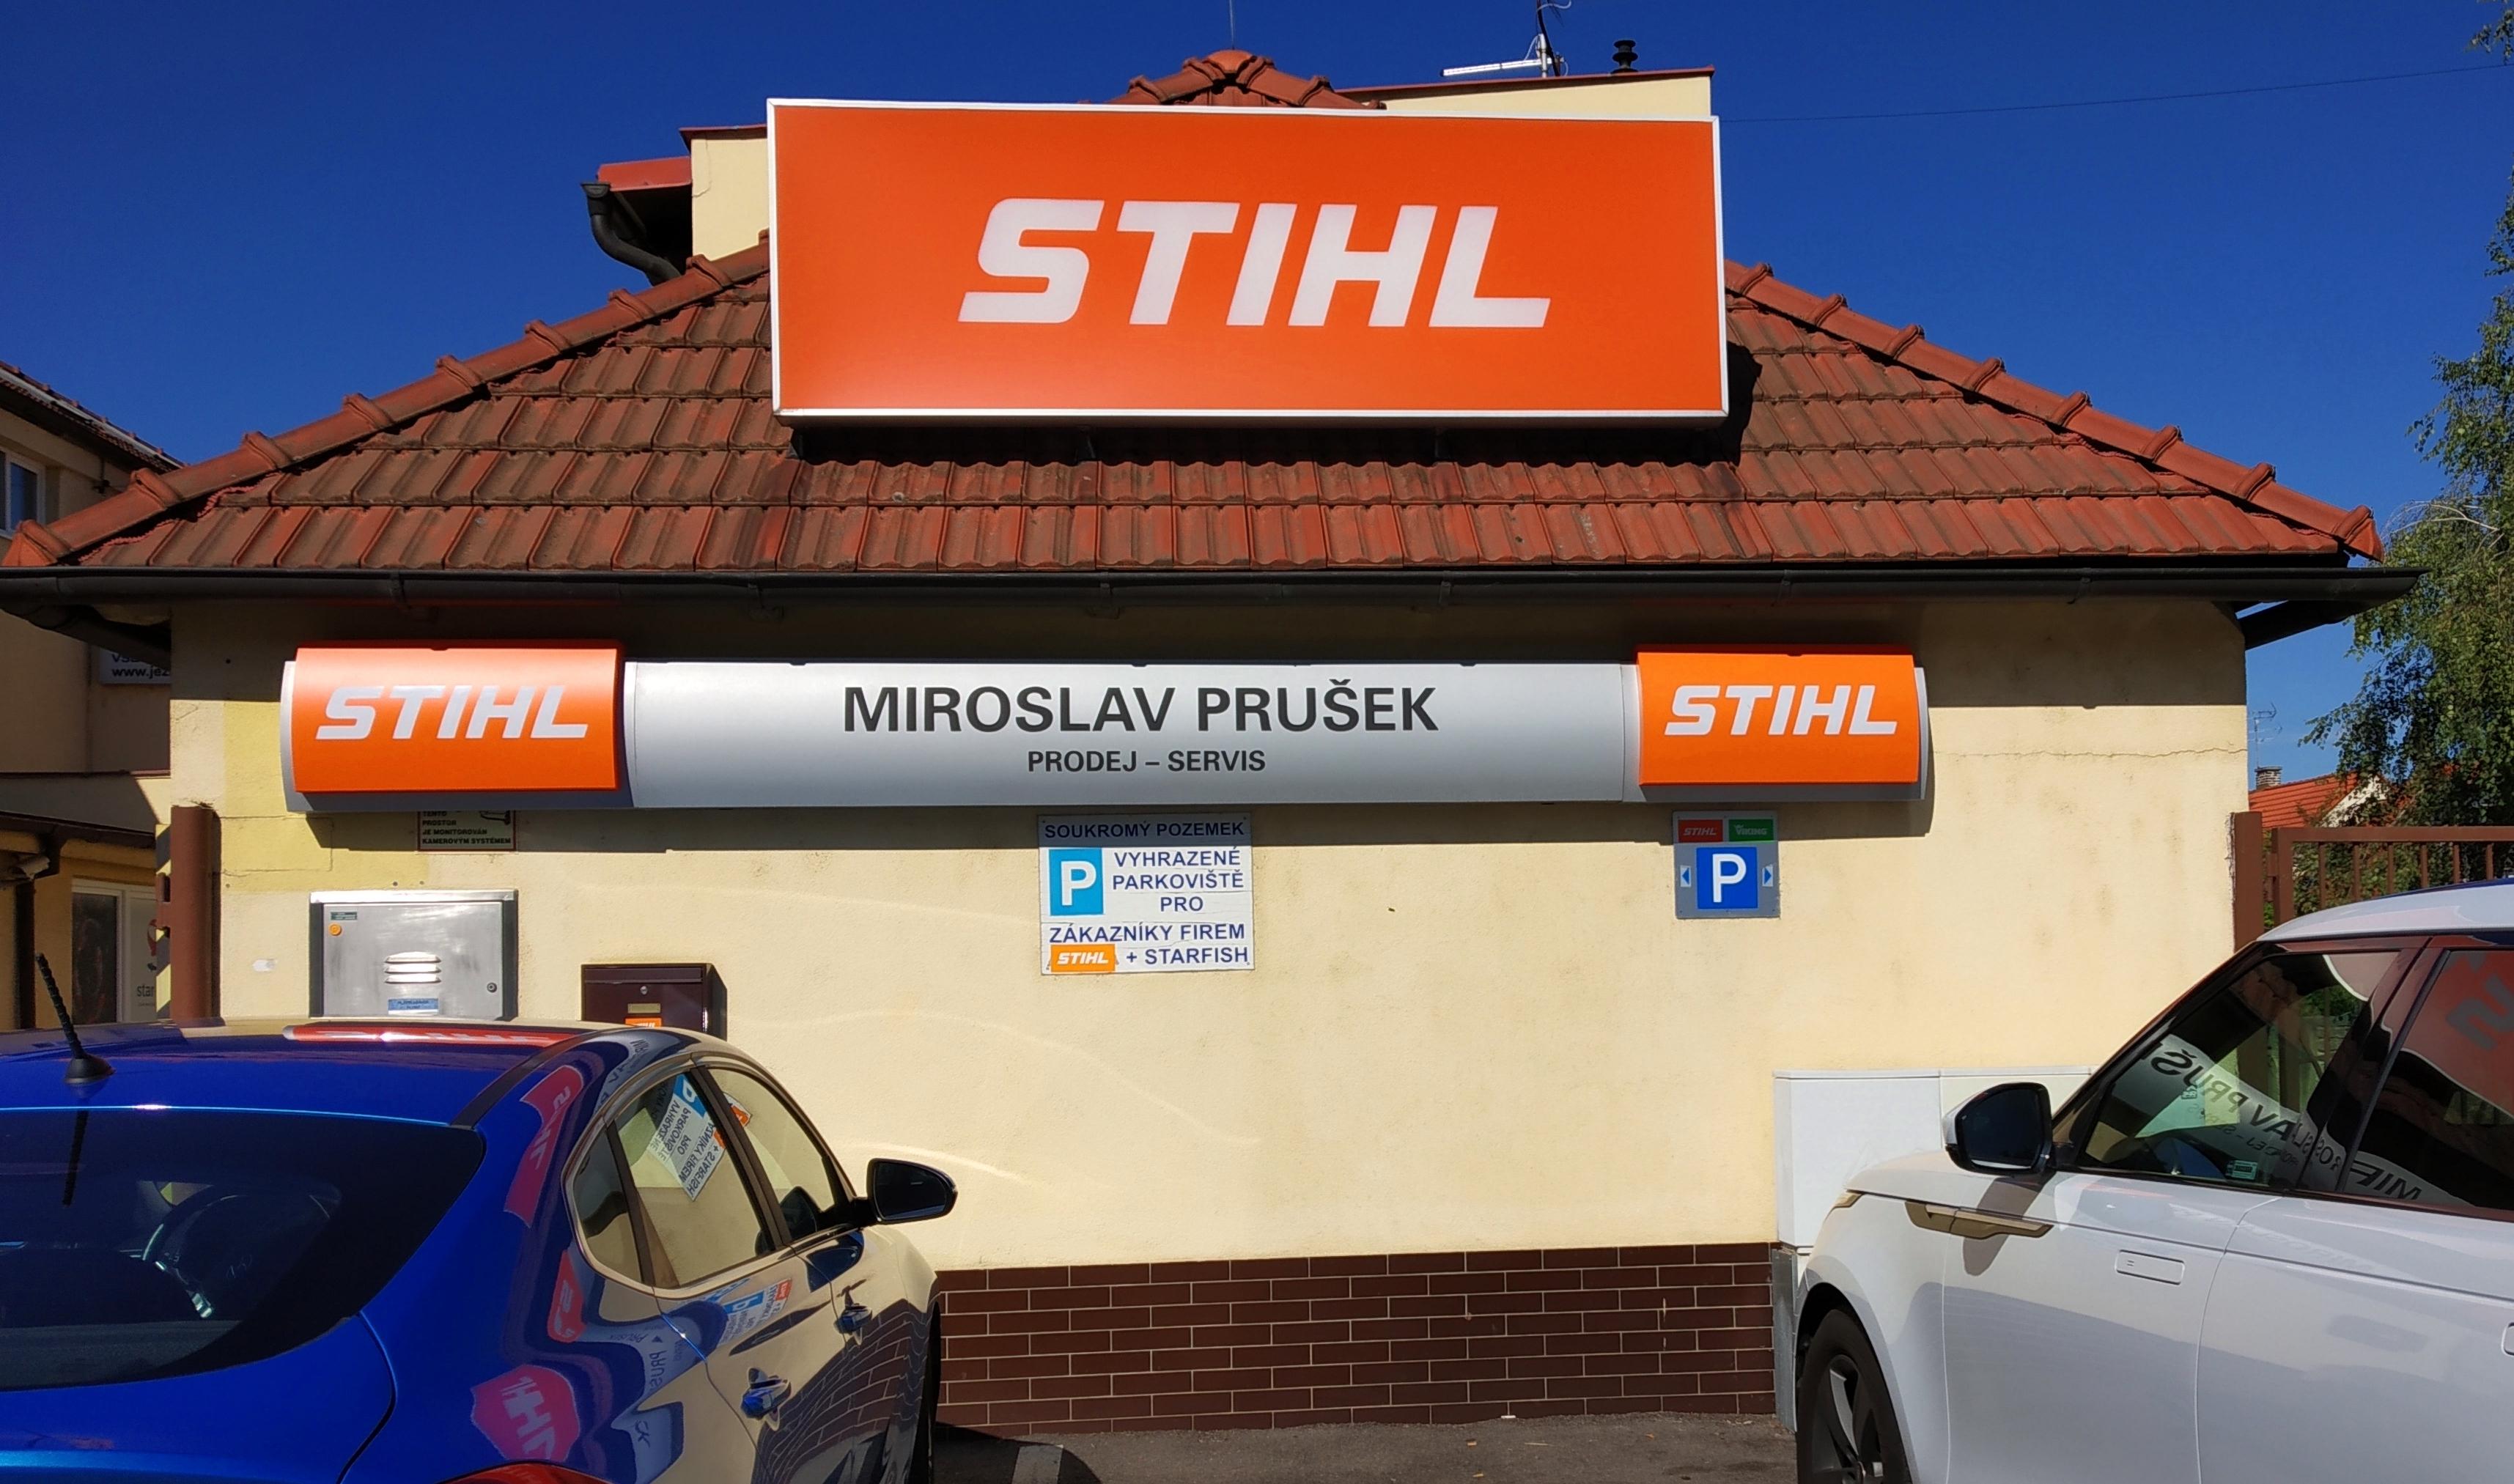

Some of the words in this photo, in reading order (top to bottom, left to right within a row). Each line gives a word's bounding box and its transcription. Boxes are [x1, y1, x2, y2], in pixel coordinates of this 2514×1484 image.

[957, 197, 1551, 328] STIHL
[315, 685, 588, 739] STIHL
[843, 686, 1176, 733] MIROSLAV
[1198, 678, 1440, 731] PRUŠEK
[1665, 684, 1898, 735] STIHL
[1028, 750, 1138, 772] PRODEJ
[1168, 750, 1267, 772] SERVIS
[1044, 819, 1150, 838] SOUKROMÝ
[1157, 822, 1245, 837] POZEMEK
[1683, 827, 1717, 836] STIHL
[1114, 846, 1241, 868] VYHRAZENÉ
[1061, 860, 1096, 906] P
[1113, 869, 1244, 890] PARKOVIŠTĚ
[1712, 853, 1747, 903] P
[1160, 896, 1203, 912] PRO
[1050, 922, 1173, 943] ZÁKAZNÍKY
[1180, 923, 1245, 940] FIREM
[1056, 951, 1109, 965] STIHL
[1145, 946, 1248, 965] STARFISH
